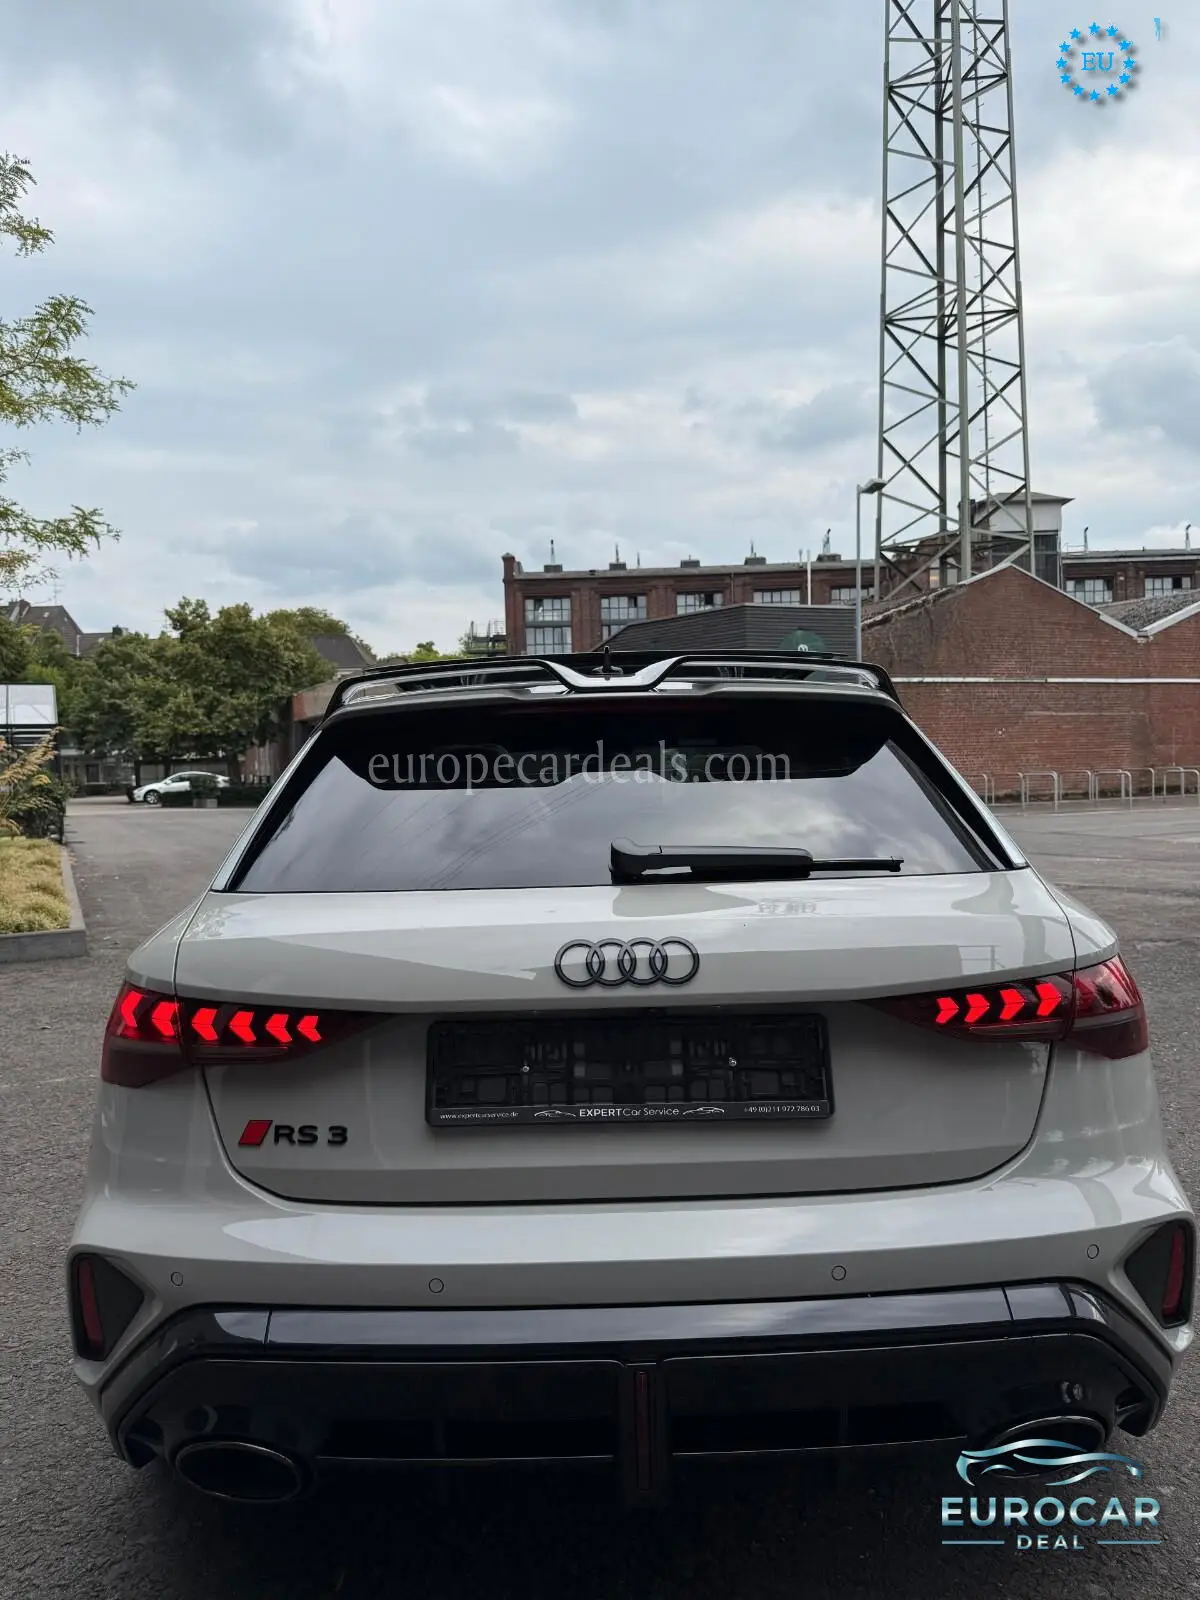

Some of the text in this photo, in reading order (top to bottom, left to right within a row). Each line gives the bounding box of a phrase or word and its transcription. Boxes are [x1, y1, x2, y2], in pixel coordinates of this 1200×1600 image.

[643, 1107, 680, 1116] Service
[273, 1125, 348, 1145] RS 3
